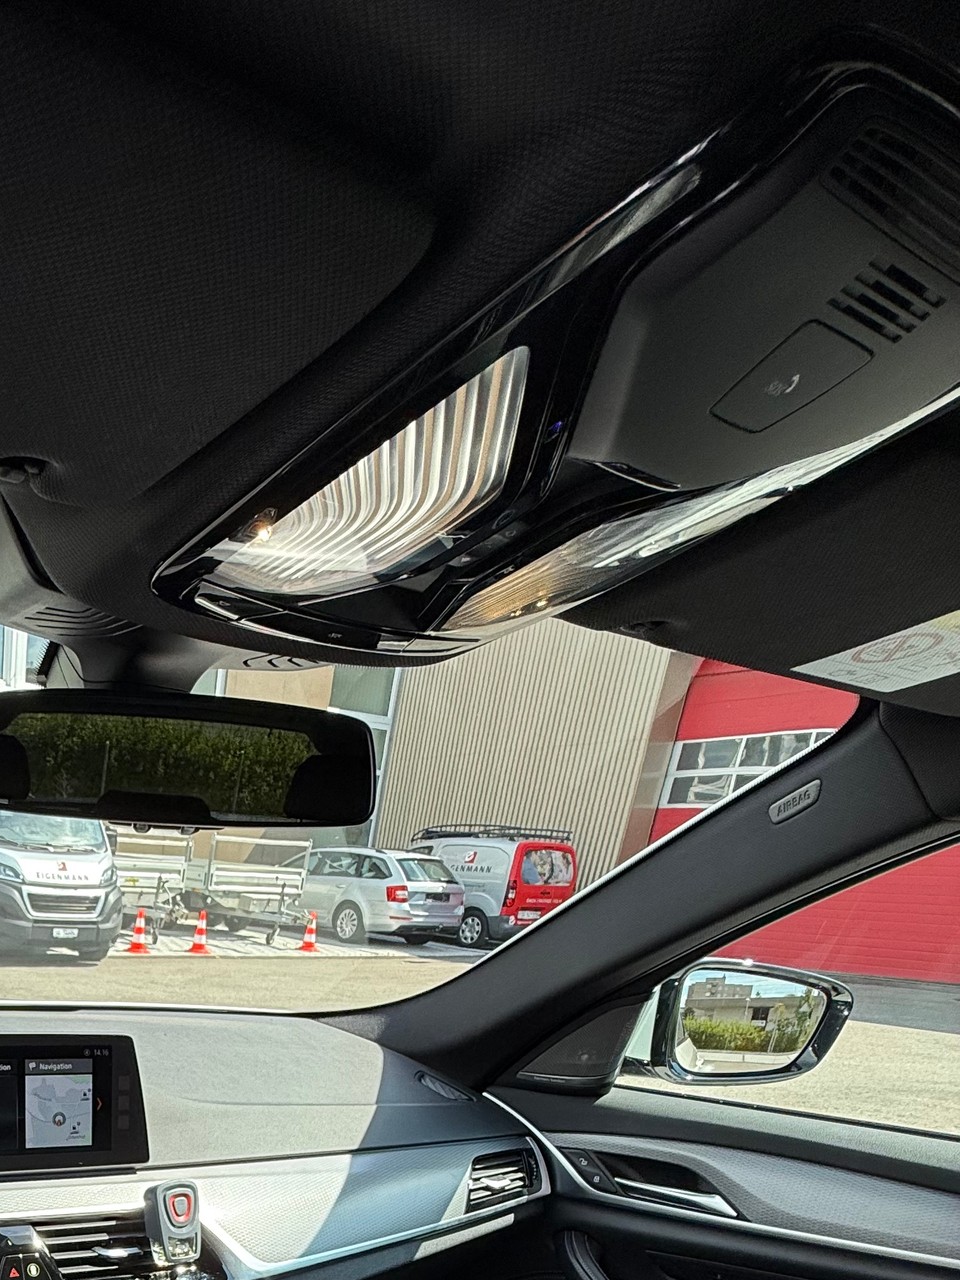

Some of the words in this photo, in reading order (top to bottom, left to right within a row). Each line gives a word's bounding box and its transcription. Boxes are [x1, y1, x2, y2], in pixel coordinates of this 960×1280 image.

[777, 789, 811, 817] AIRBAG
[450, 864, 492, 873] GENMANN
[36, 872, 89, 881] EIGENMANN
[39, 1063, 72, 1071] Navigation
